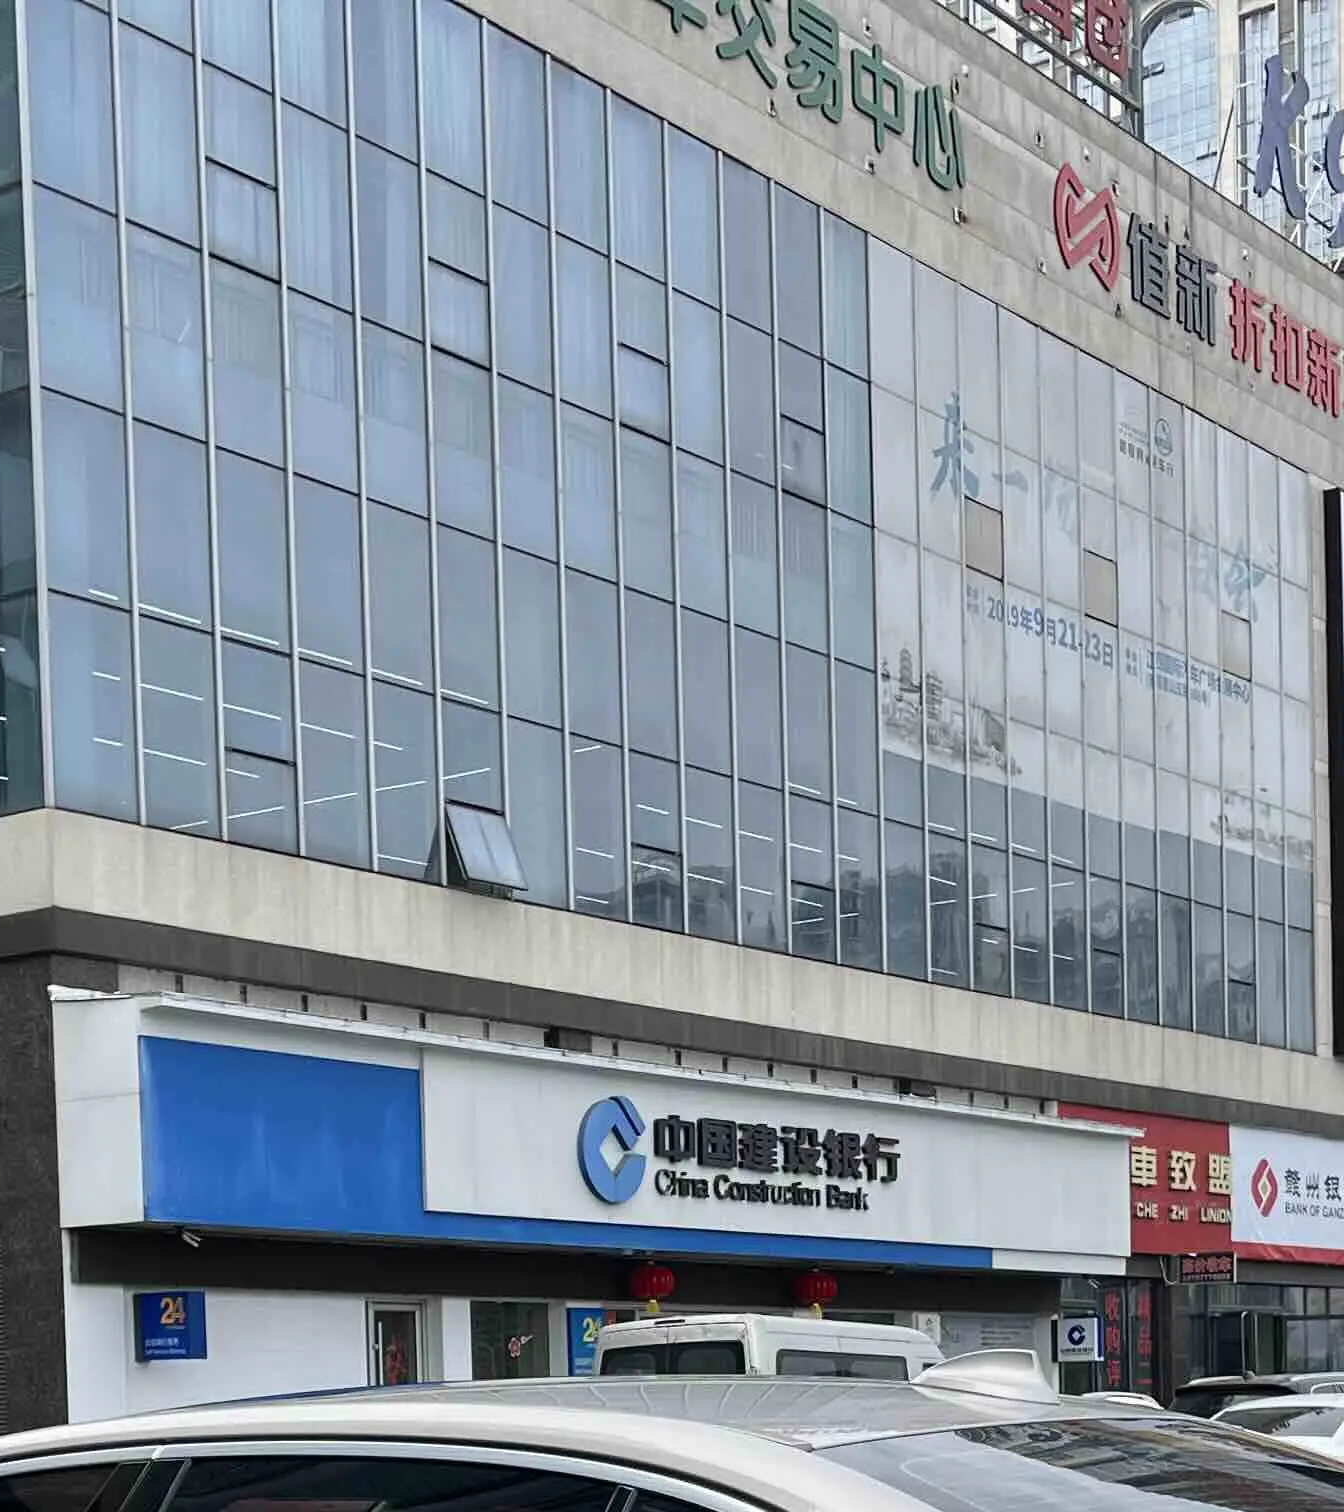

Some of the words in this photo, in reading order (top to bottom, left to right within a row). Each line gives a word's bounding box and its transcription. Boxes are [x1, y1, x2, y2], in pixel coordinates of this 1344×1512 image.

[654, 1114, 902, 1184] 中国建设银行
[655, 1168, 710, 1199] China
[713, 1173, 821, 1208] Construction
[826, 1184, 870, 1211] Bank
[1284, 1202, 1308, 1216] BANK
[1309, 1206, 1321, 1217] OF
[160, 1296, 186, 1325] 24
